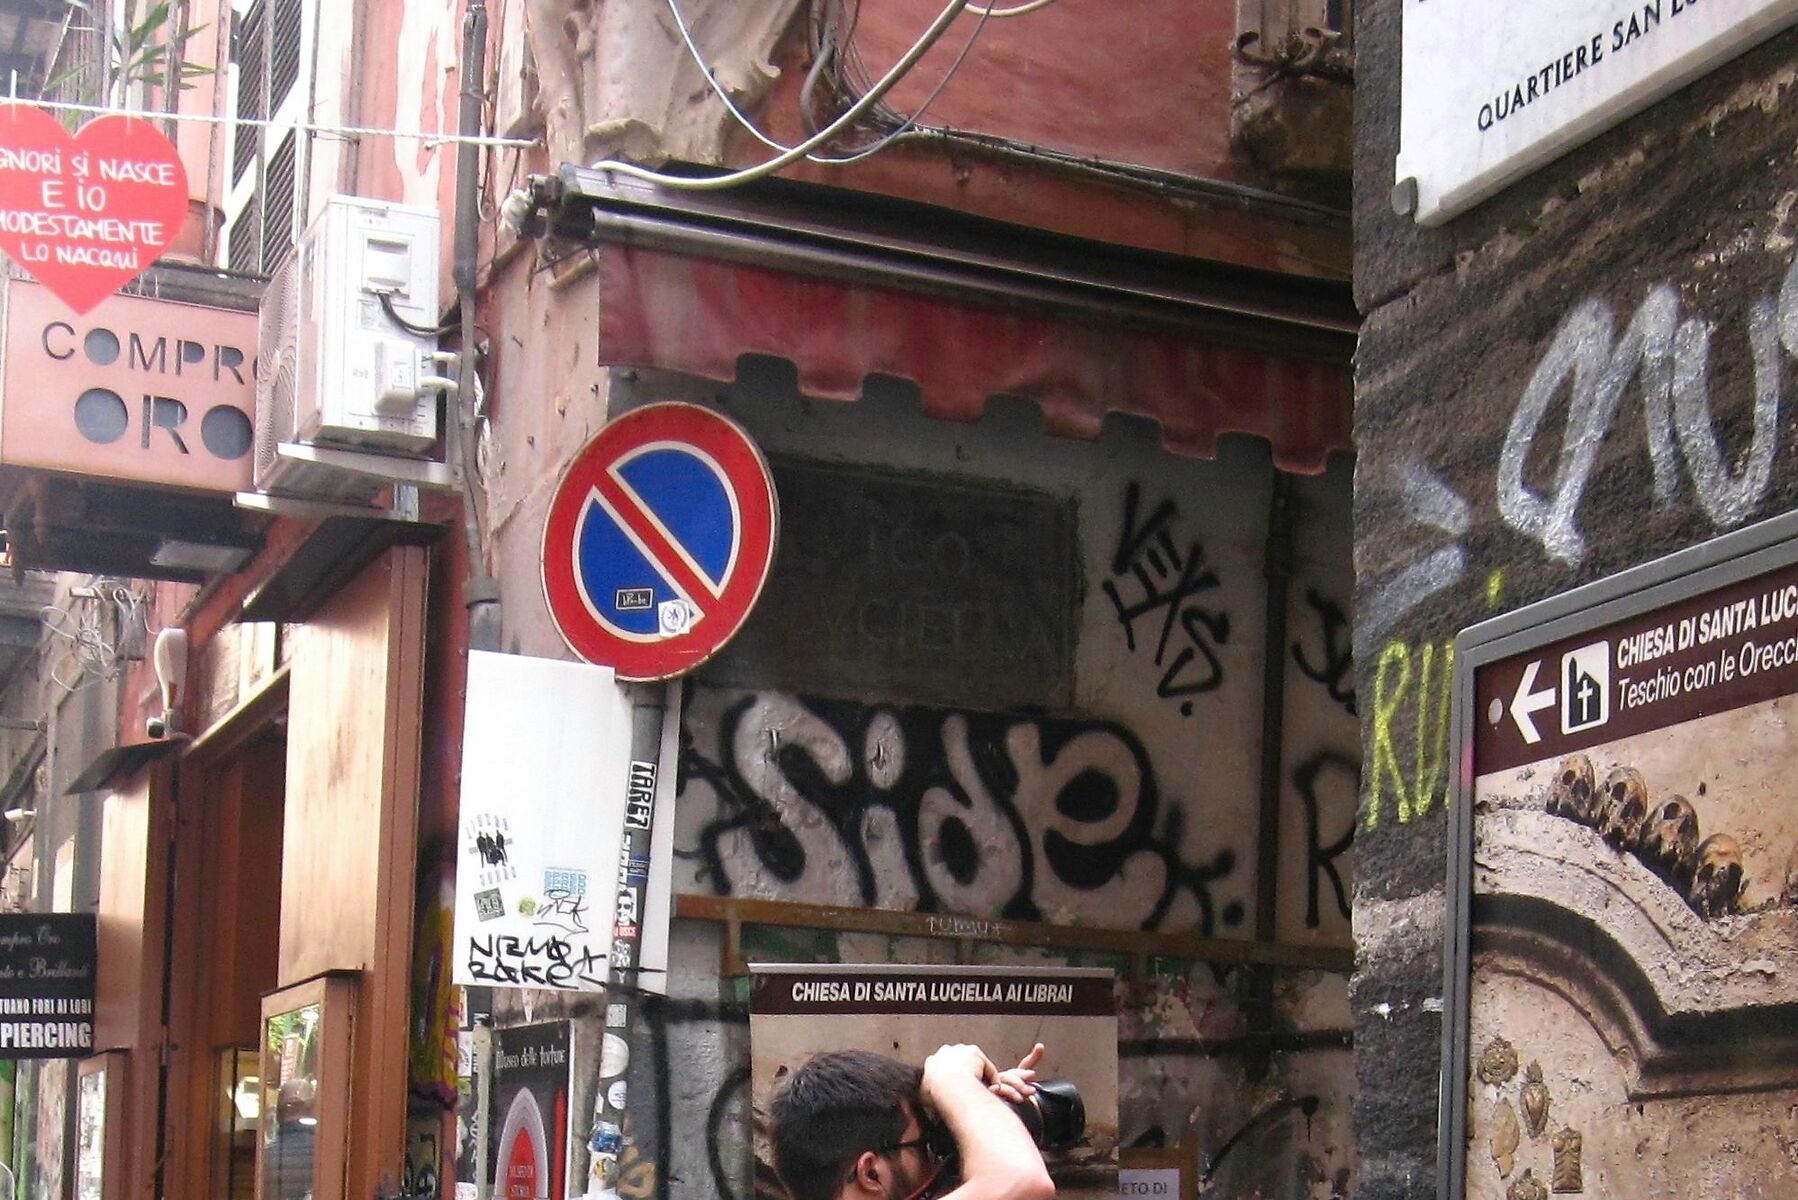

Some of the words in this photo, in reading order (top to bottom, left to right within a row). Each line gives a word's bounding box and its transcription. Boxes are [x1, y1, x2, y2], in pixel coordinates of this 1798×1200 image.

[1477, 34, 1603, 132] QUARTIERE
[1611, 0, 1661, 53] SAN
[100, 159, 175, 186] NASCE
[42, 181, 65, 208] E
[21, 241, 49, 262] LO
[42, 320, 258, 385] COMPR
[74, 388, 252, 460] ORO
[1617, 624, 1674, 669] CHIESA
[1678, 617, 1697, 650] DI
[1699, 598, 1756, 645] SANTA
[1760, 585, 1798, 626] LUC
[1619, 666, 1680, 711] Teschio
[1684, 661, 1715, 692] con
[1719, 649, 1735, 682] le
[1740, 637, 1798, 677] Orecc
[792, 982, 850, 1001] CHIESA
[854, 982, 870, 1001] DI
[874, 983, 927, 1002] SANTA
[930, 983, 1003, 1002] LUCIELLA
[1006, 984, 1022, 1002] AI
[1025, 984, 1072, 1003] LIBRAI
[0, 1022, 92, 1048] PIERCING
[1121, 1182, 1149, 1196] ETO
[1152, 1182, 1168, 1195] DI
